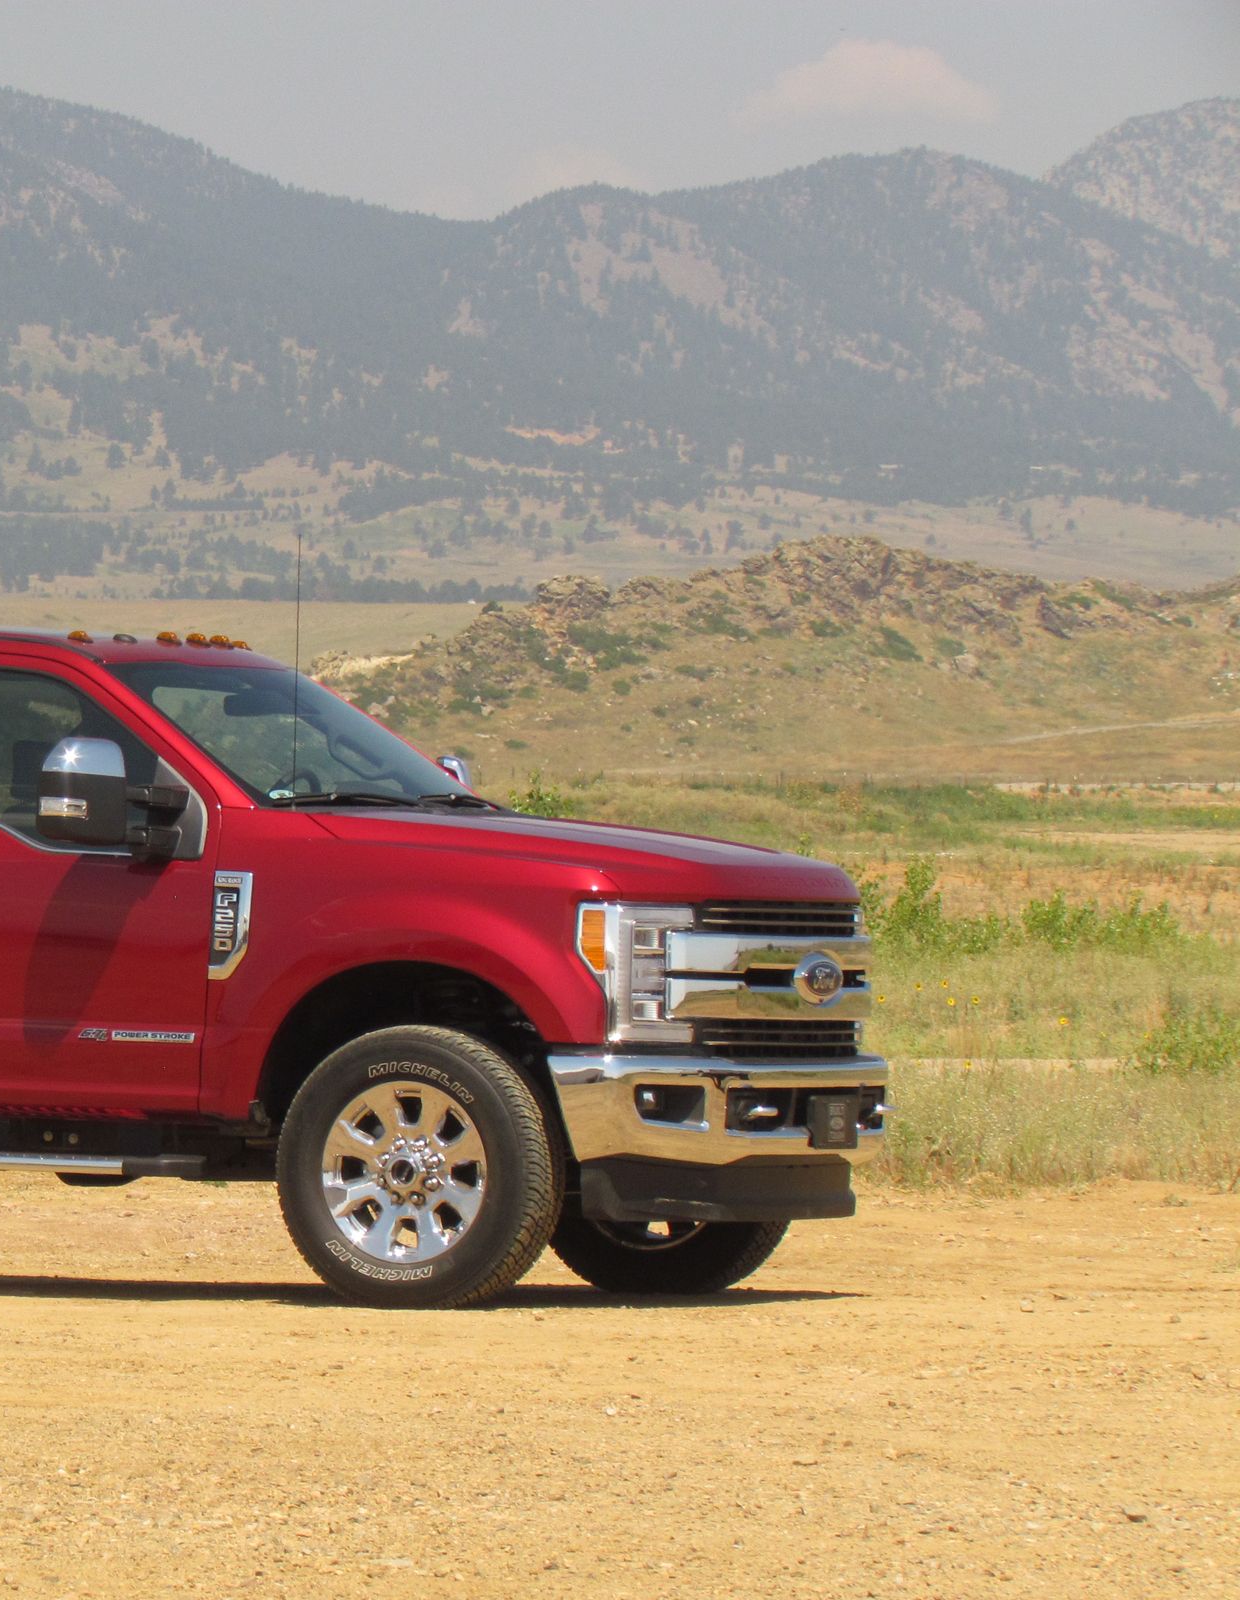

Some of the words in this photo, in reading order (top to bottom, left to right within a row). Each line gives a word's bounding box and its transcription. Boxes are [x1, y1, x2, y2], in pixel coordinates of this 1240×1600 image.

[813, 967, 836, 989] Ford
[150, 1032, 191, 1040] STROKE
[368, 1061, 474, 1104] MICHELIN
[325, 1239, 433, 1281] MICHELIN
